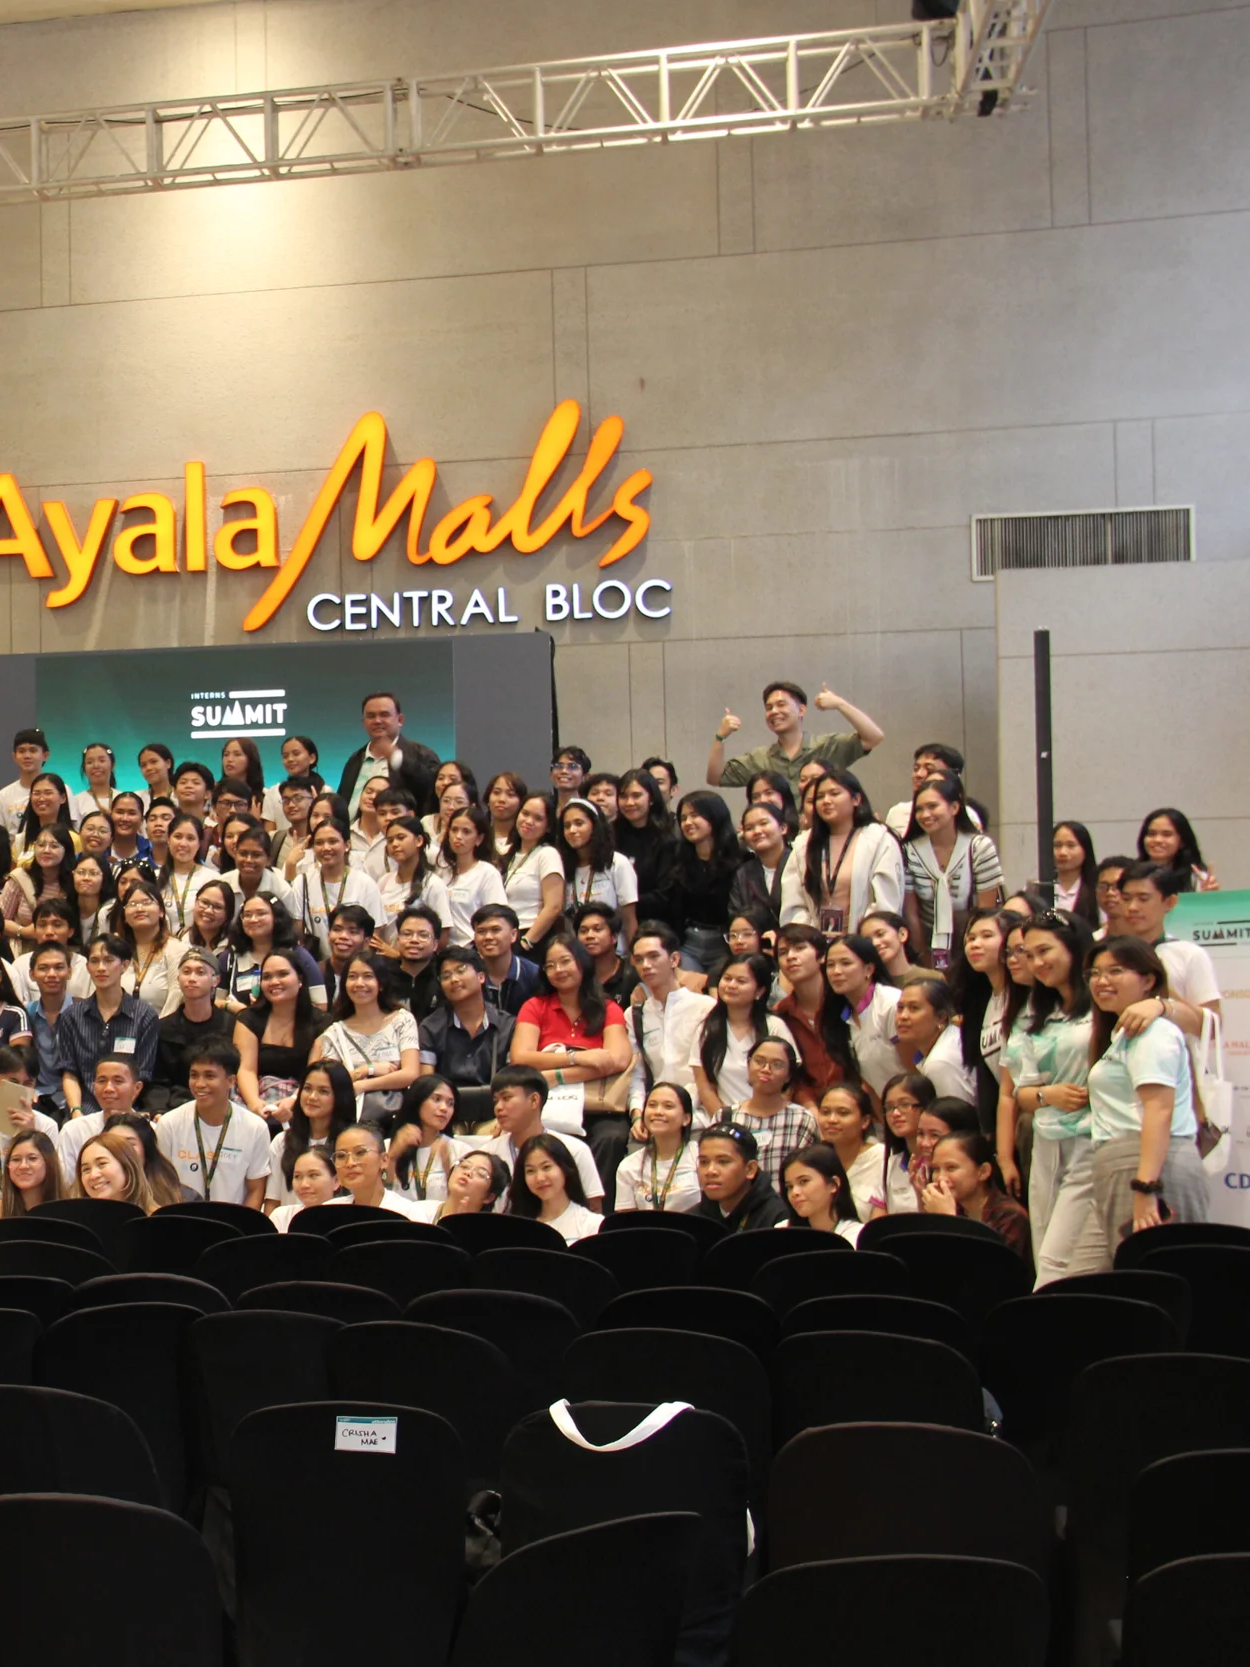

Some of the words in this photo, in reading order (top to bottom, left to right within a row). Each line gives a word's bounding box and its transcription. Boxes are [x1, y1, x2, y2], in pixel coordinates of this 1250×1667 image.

[241, 398, 653, 633] Malls
[306, 587, 519, 632] CENTRAL
[545, 578, 673, 623] BLOC
[191, 691, 226, 700] INTERNS
[191, 700, 288, 727] SUMMIT
[341, 1428, 378, 1438] CRISHA
